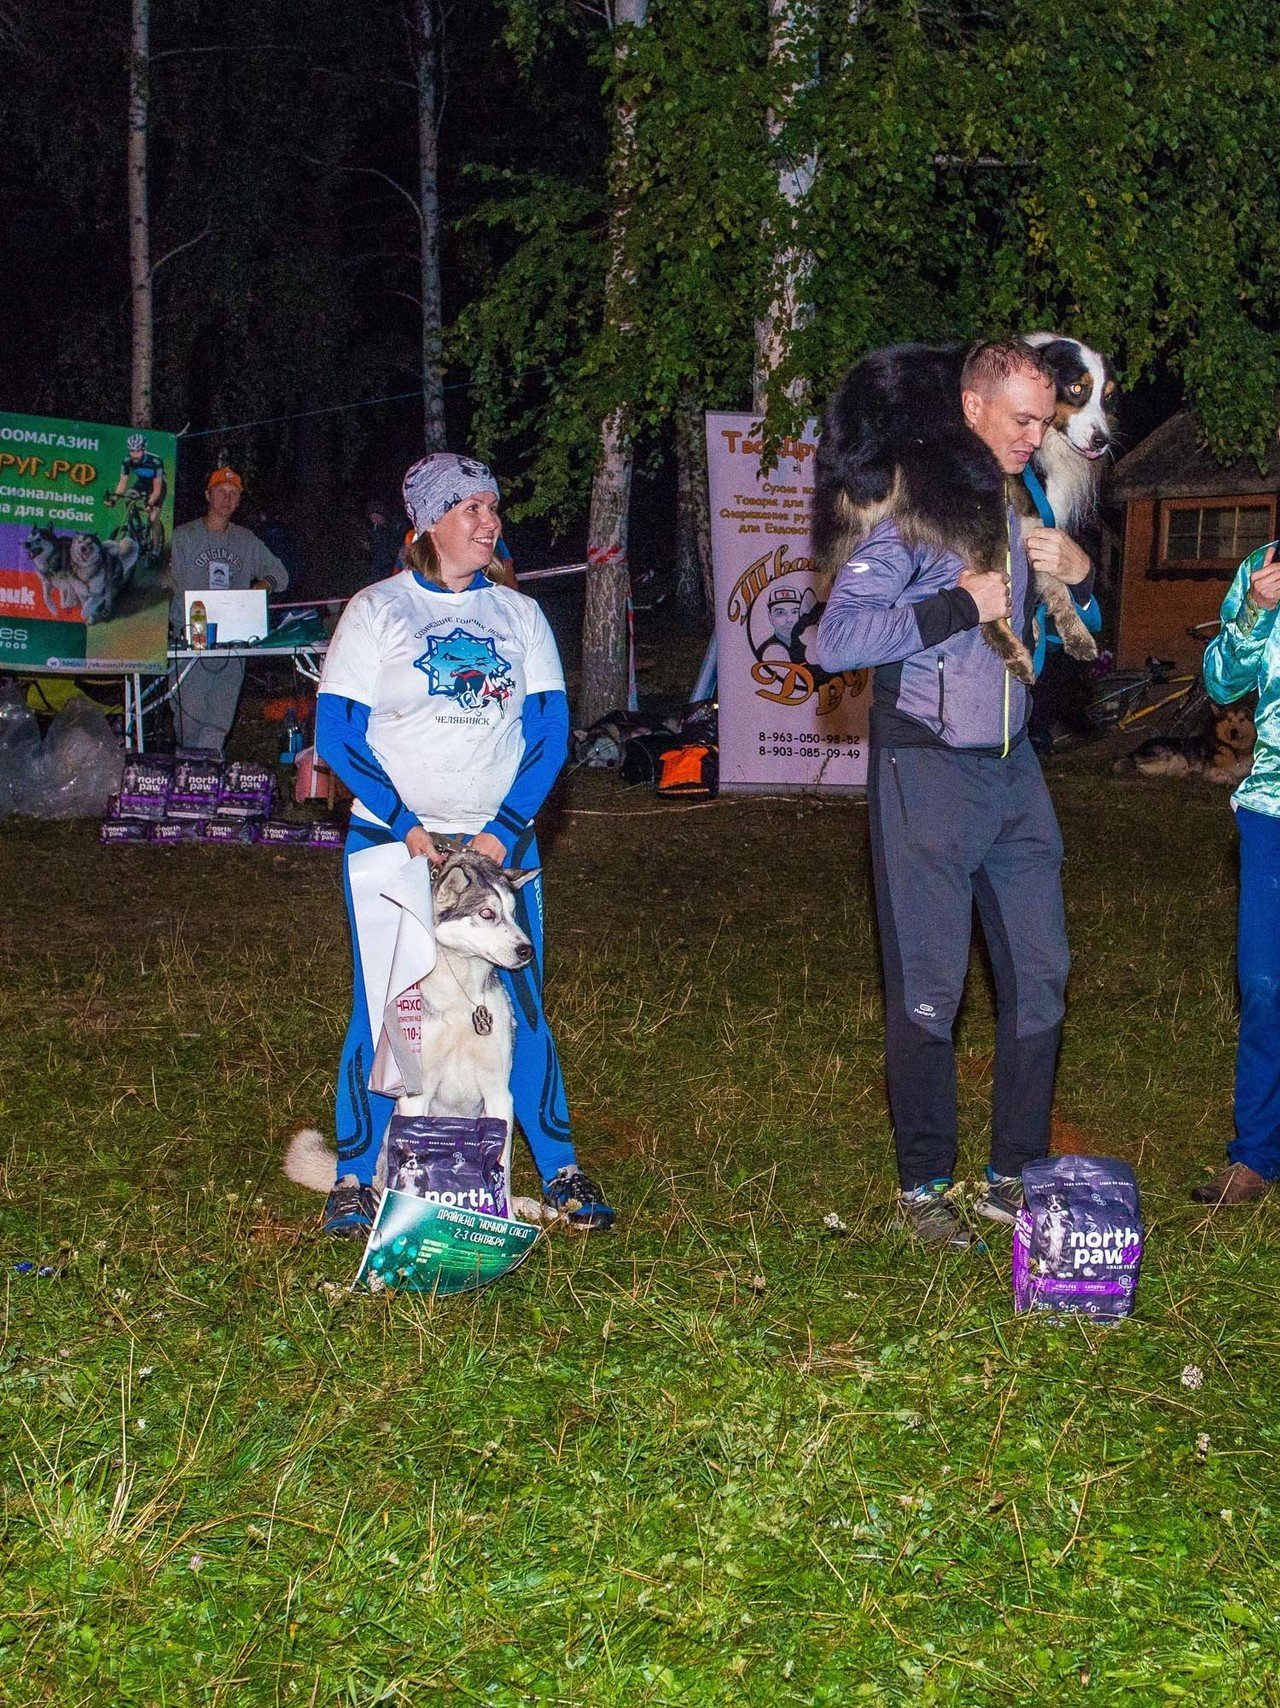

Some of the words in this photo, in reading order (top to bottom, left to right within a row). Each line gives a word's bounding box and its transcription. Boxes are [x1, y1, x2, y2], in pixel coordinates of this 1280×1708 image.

[14, 505, 45, 517] для
[48, 508, 94, 522] собак
[434, 715, 490, 726] ЧЕЛЯБИНСК
[758, 746, 861, 759] 8-903-085-09-49
[138, 776, 168, 785] north
[188, 776, 218, 785] north
[240, 773, 268, 783] north
[139, 784, 160, 792] paw
[190, 783, 212, 791] paw
[241, 781, 261, 790] paw
[425, 1188, 494, 1208] north
[454, 1228, 469, 1240] 2-3
[470, 1231, 506, 1247] СЕНТЯБРЯ
[1071, 1228, 1140, 1248] north
[1074, 1248, 1124, 1269] paw
